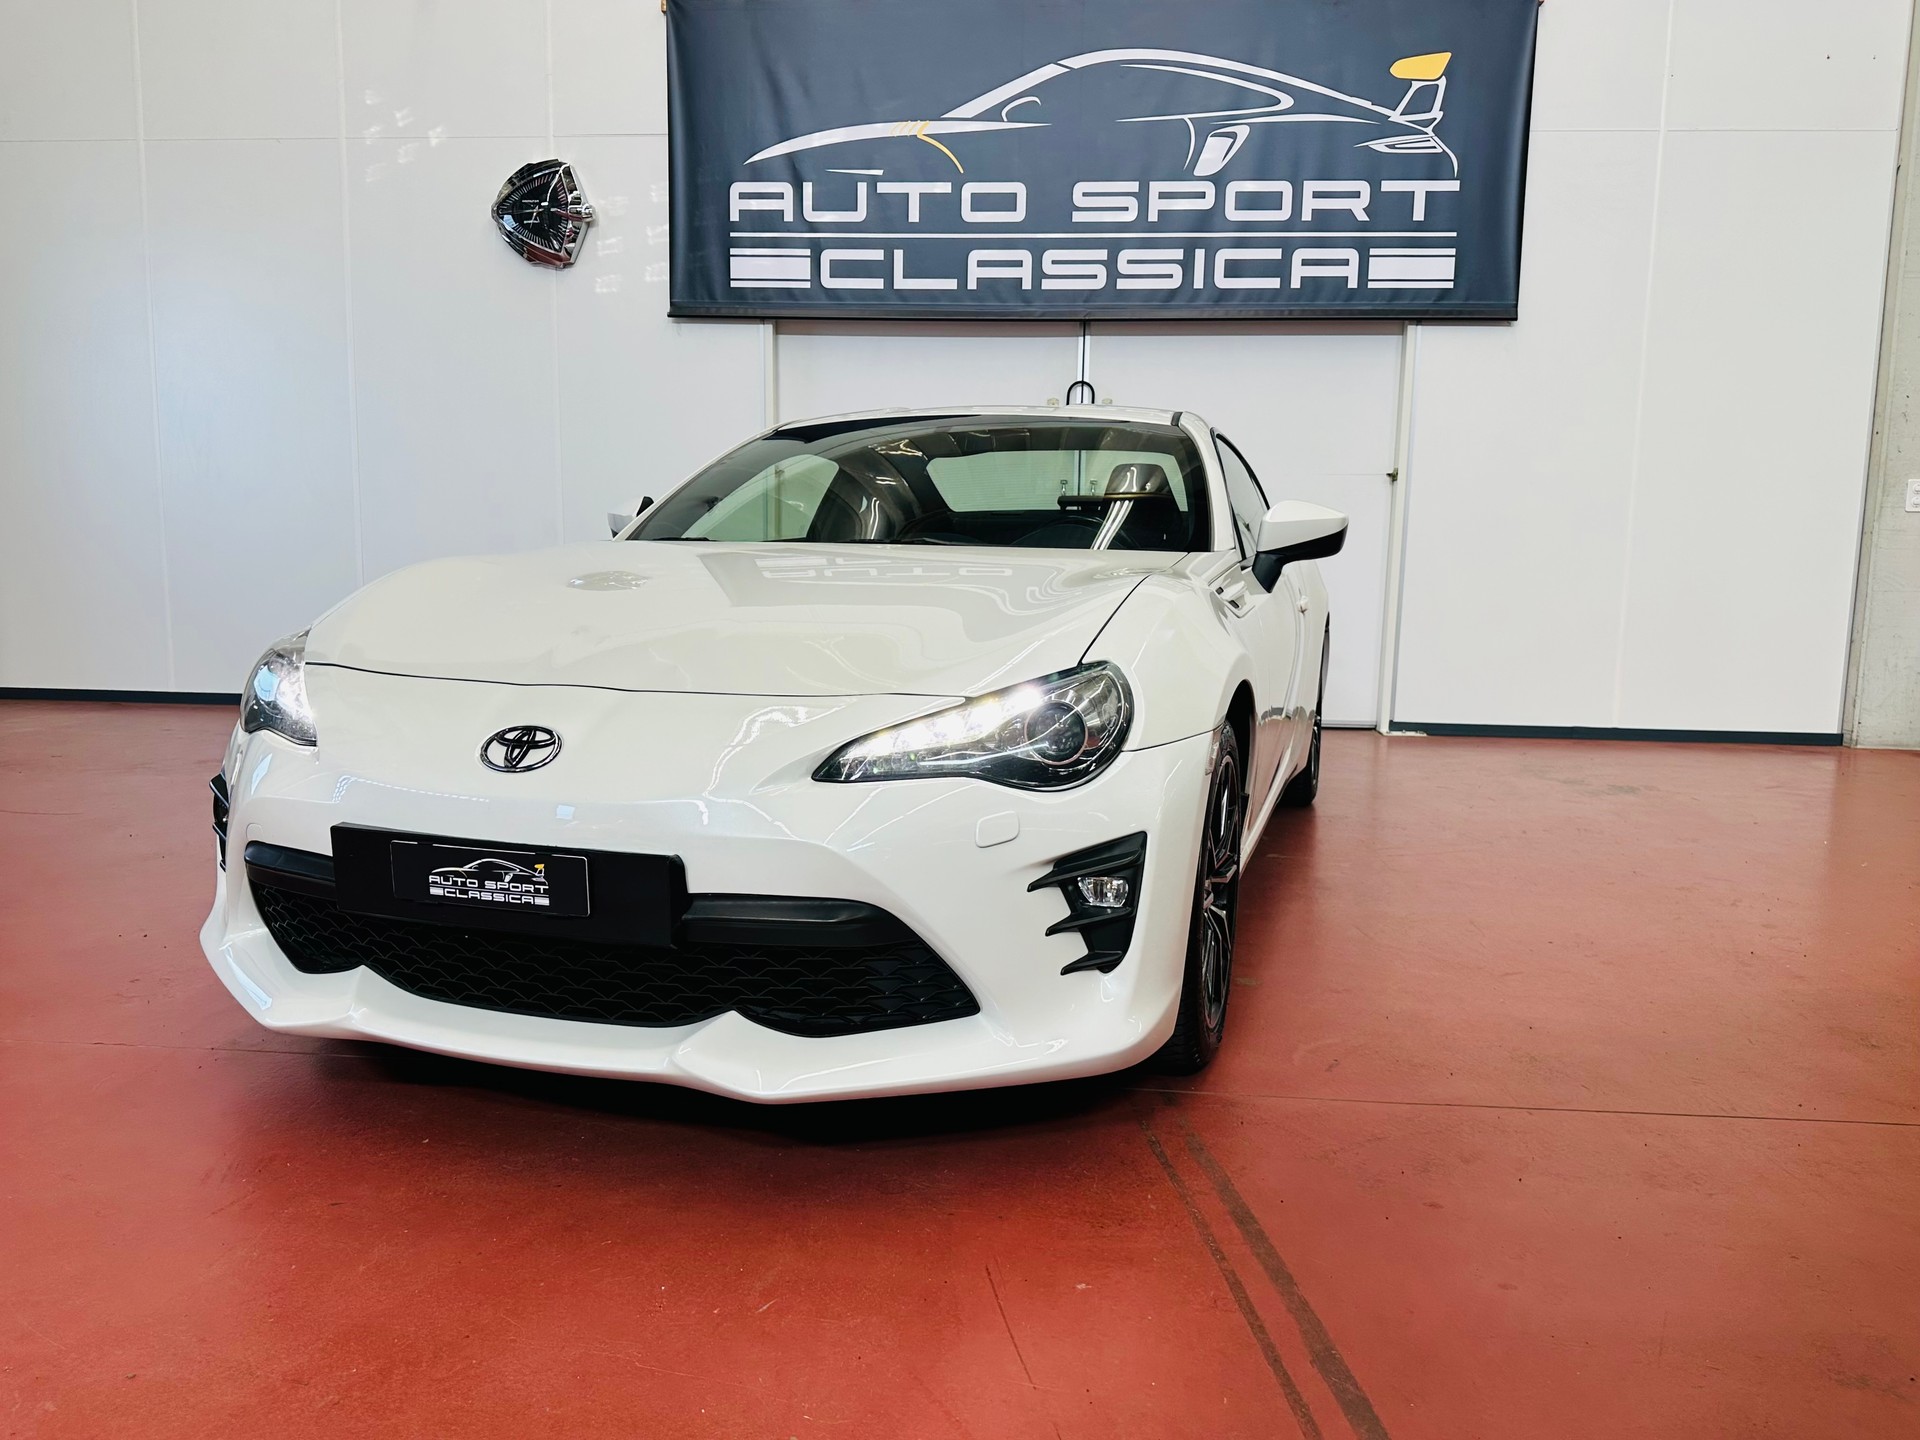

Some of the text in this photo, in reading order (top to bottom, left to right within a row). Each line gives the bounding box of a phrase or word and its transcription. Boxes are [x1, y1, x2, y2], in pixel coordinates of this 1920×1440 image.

[729, 180, 1461, 223] AUTO SPORT
[820, 248, 1360, 290] CLASSICA
[428, 874, 549, 894] AUTO SPORT
[444, 888, 534, 905] CLASSICA
